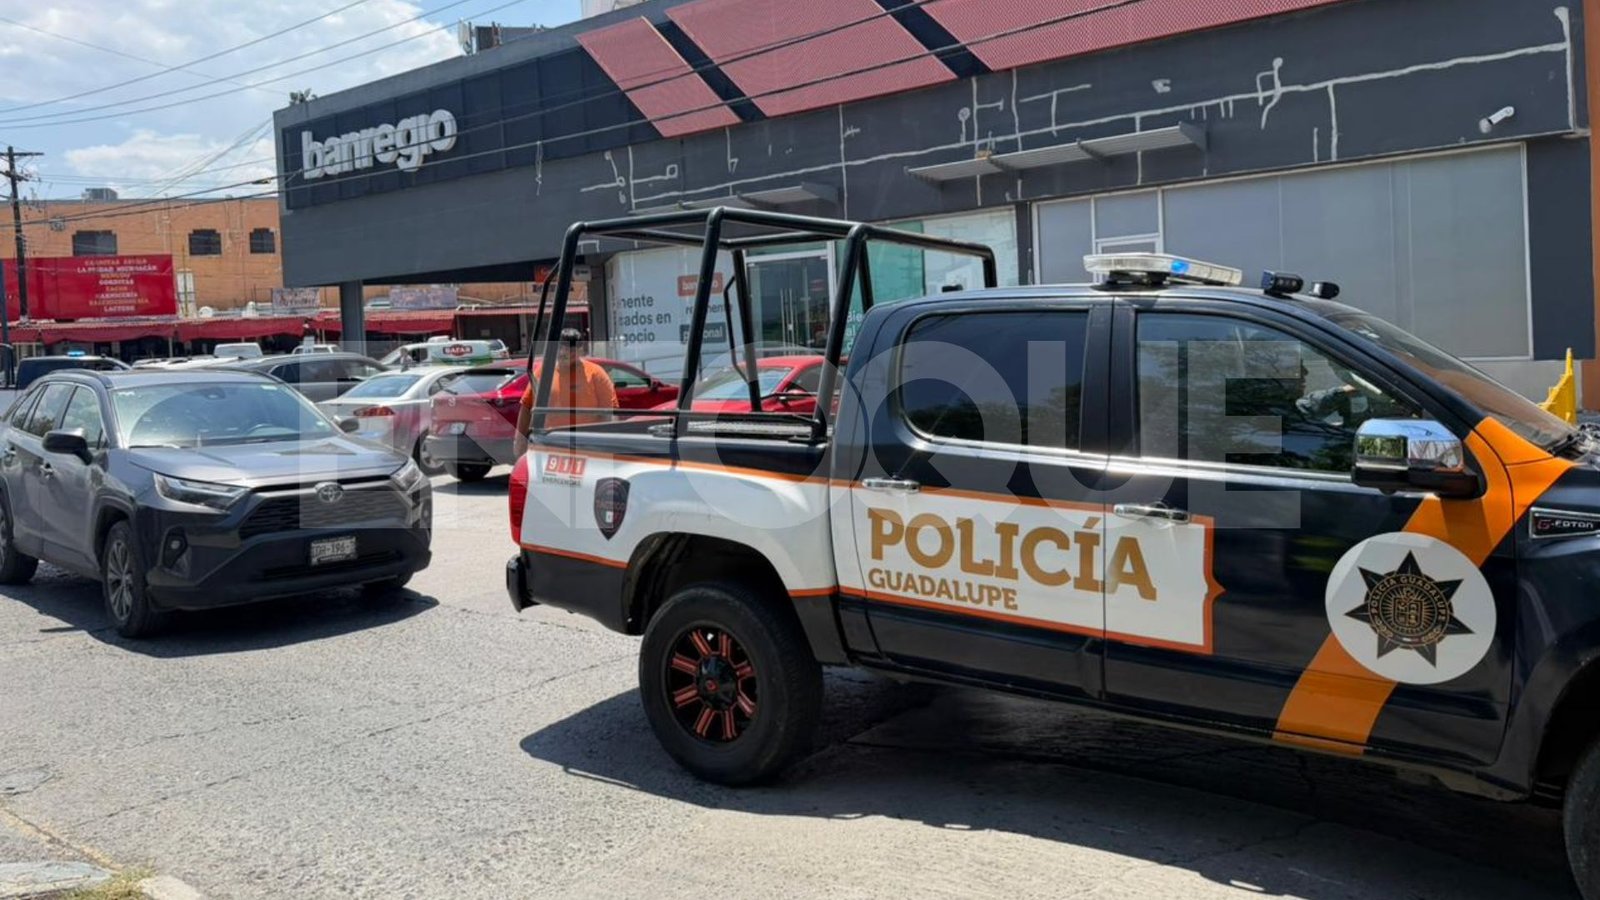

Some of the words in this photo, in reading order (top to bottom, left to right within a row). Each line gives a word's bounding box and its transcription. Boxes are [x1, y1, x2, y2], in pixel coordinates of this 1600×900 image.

[302, 108, 458, 180] banregio
[656, 312, 671, 325] en
[547, 457, 583, 475] 911
[867, 507, 1157, 601] POLICÍA
[868, 568, 1018, 610] GUADALUPE
[1371, 578, 1397, 614] POLICÍA
[1399, 576, 1447, 621] GUADALUPE
